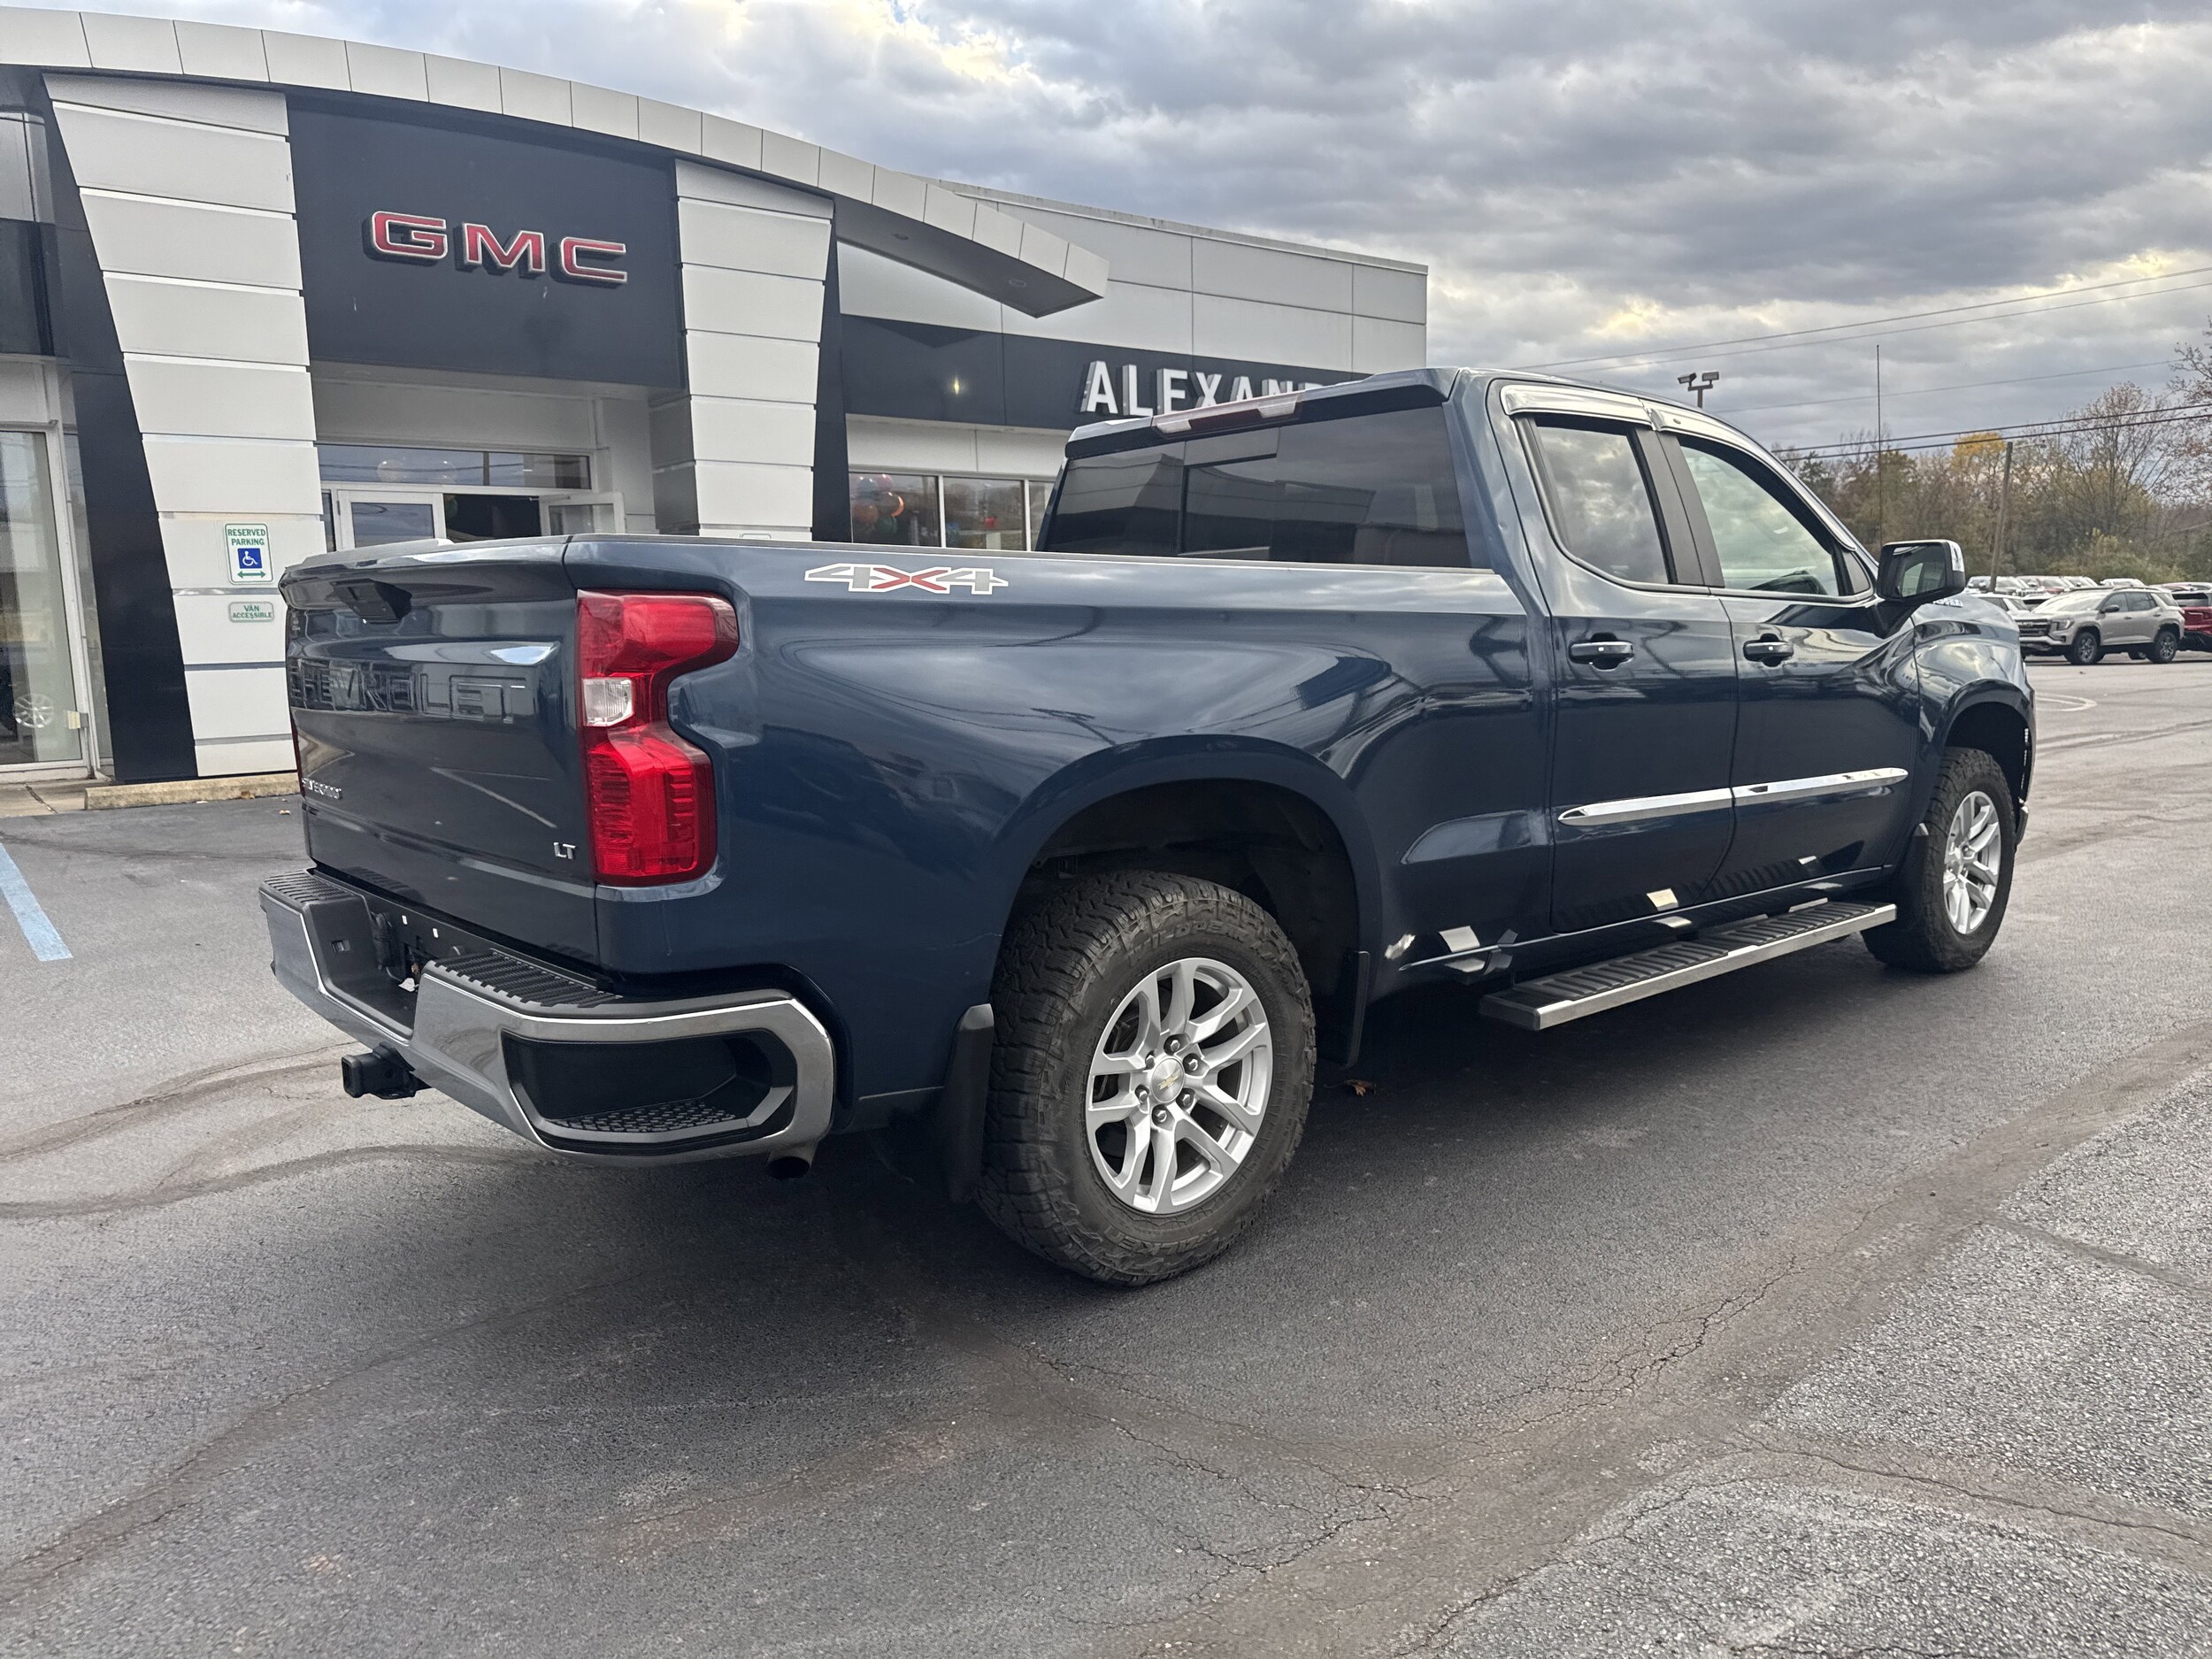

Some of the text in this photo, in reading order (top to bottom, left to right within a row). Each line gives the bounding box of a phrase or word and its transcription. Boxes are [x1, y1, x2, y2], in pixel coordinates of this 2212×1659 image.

[372, 211, 627, 283] GMC
[227, 528, 266, 537] RESERVED
[290, 659, 526, 724] CHEVROLET
[553, 841, 577, 860] LT
